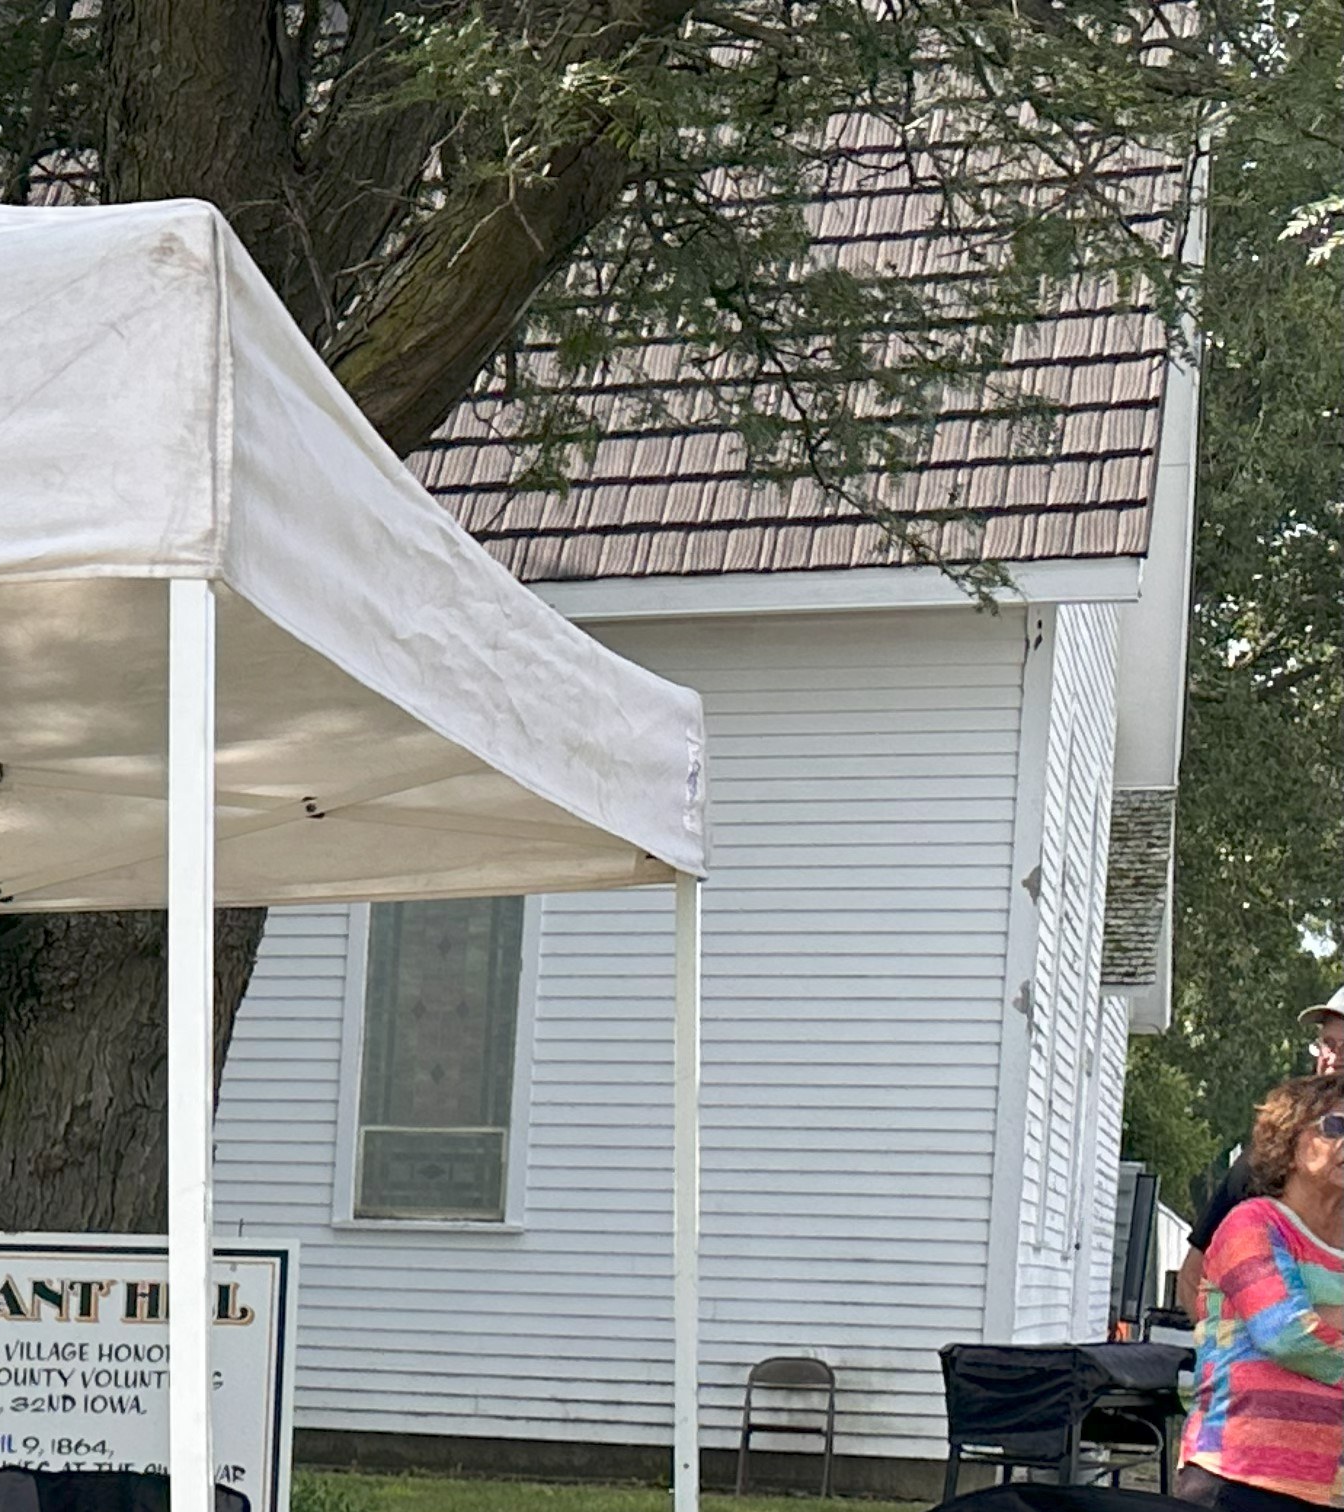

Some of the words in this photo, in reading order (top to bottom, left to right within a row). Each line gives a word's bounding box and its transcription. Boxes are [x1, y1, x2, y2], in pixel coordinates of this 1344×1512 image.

[121, 1279, 256, 1326] HL
[5, 1340, 89, 1362] VILLAGE
[98, 1343, 170, 1364] HONO
[81, 1367, 224, 1391] VOLUNTS
[10, 1394, 76, 1413] 32ND
[84, 1394, 147, 1415] IOWA.
[22, 1436, 44, 1456] 9,
[51, 1438, 115, 1458] 1864,
